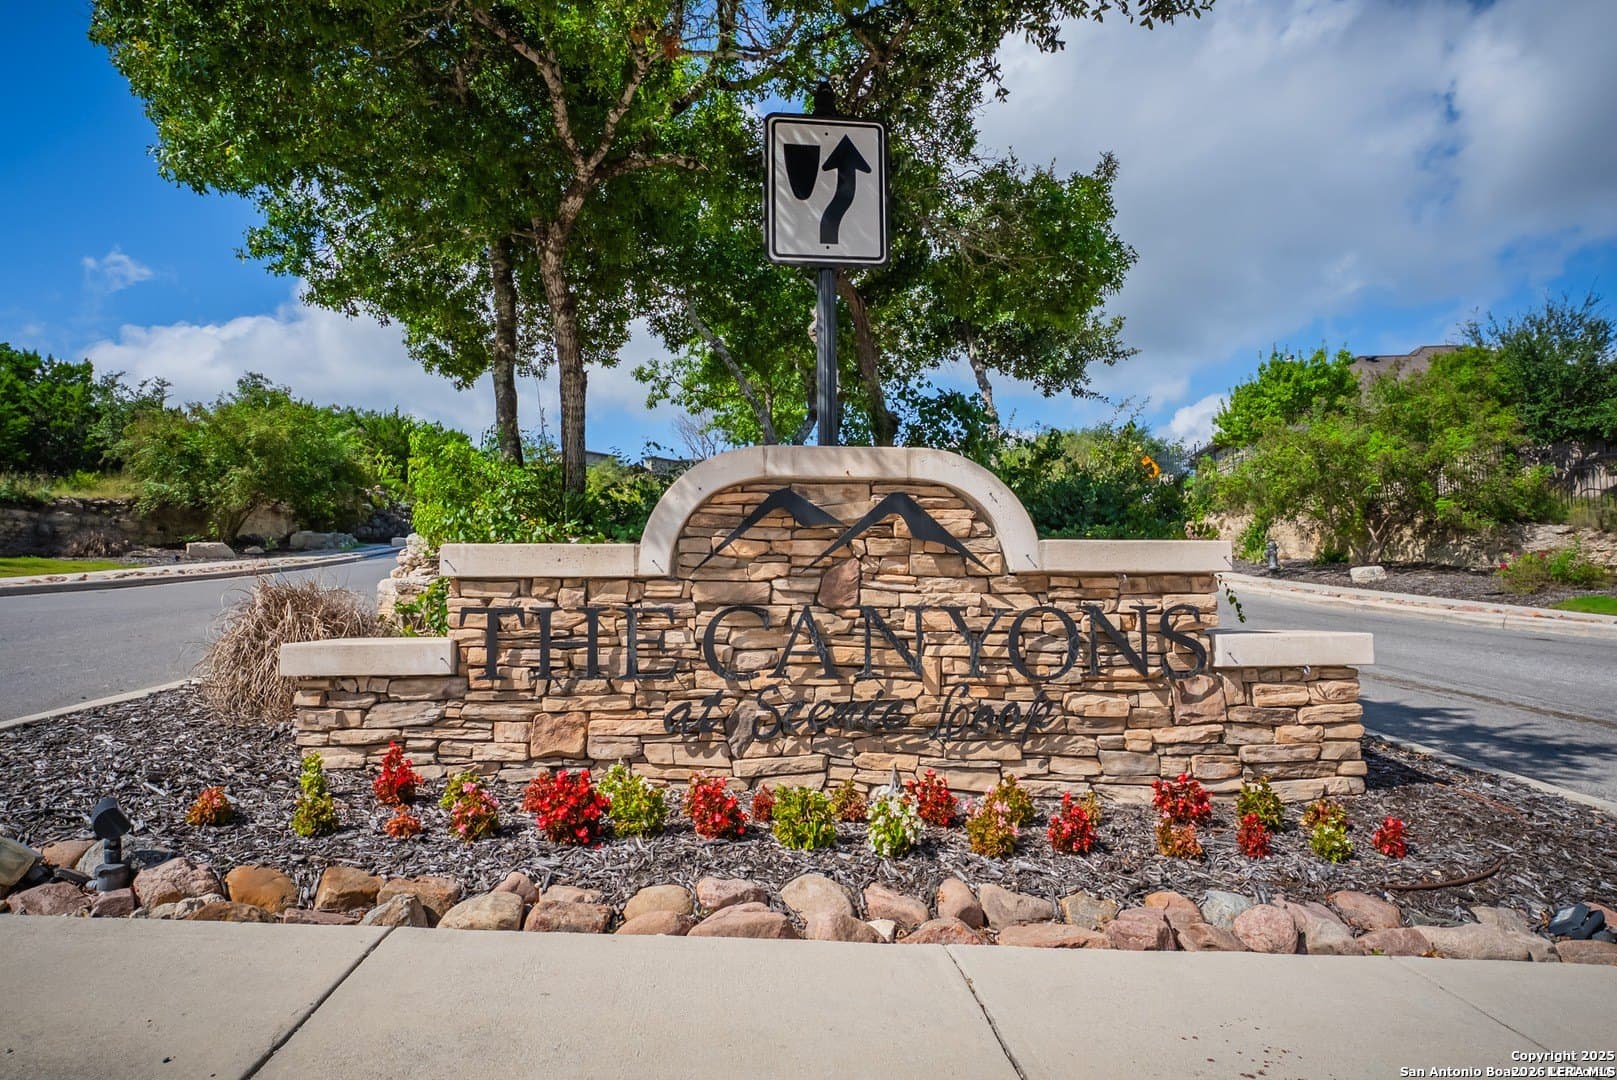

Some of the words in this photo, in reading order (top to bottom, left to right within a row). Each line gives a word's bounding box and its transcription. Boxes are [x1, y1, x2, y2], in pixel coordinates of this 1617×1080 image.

[460, 606, 679, 681] THE
[703, 604, 1207, 681] CANYONS
[664, 689, 724, 734] at
[752, 684, 906, 740] Scenic
